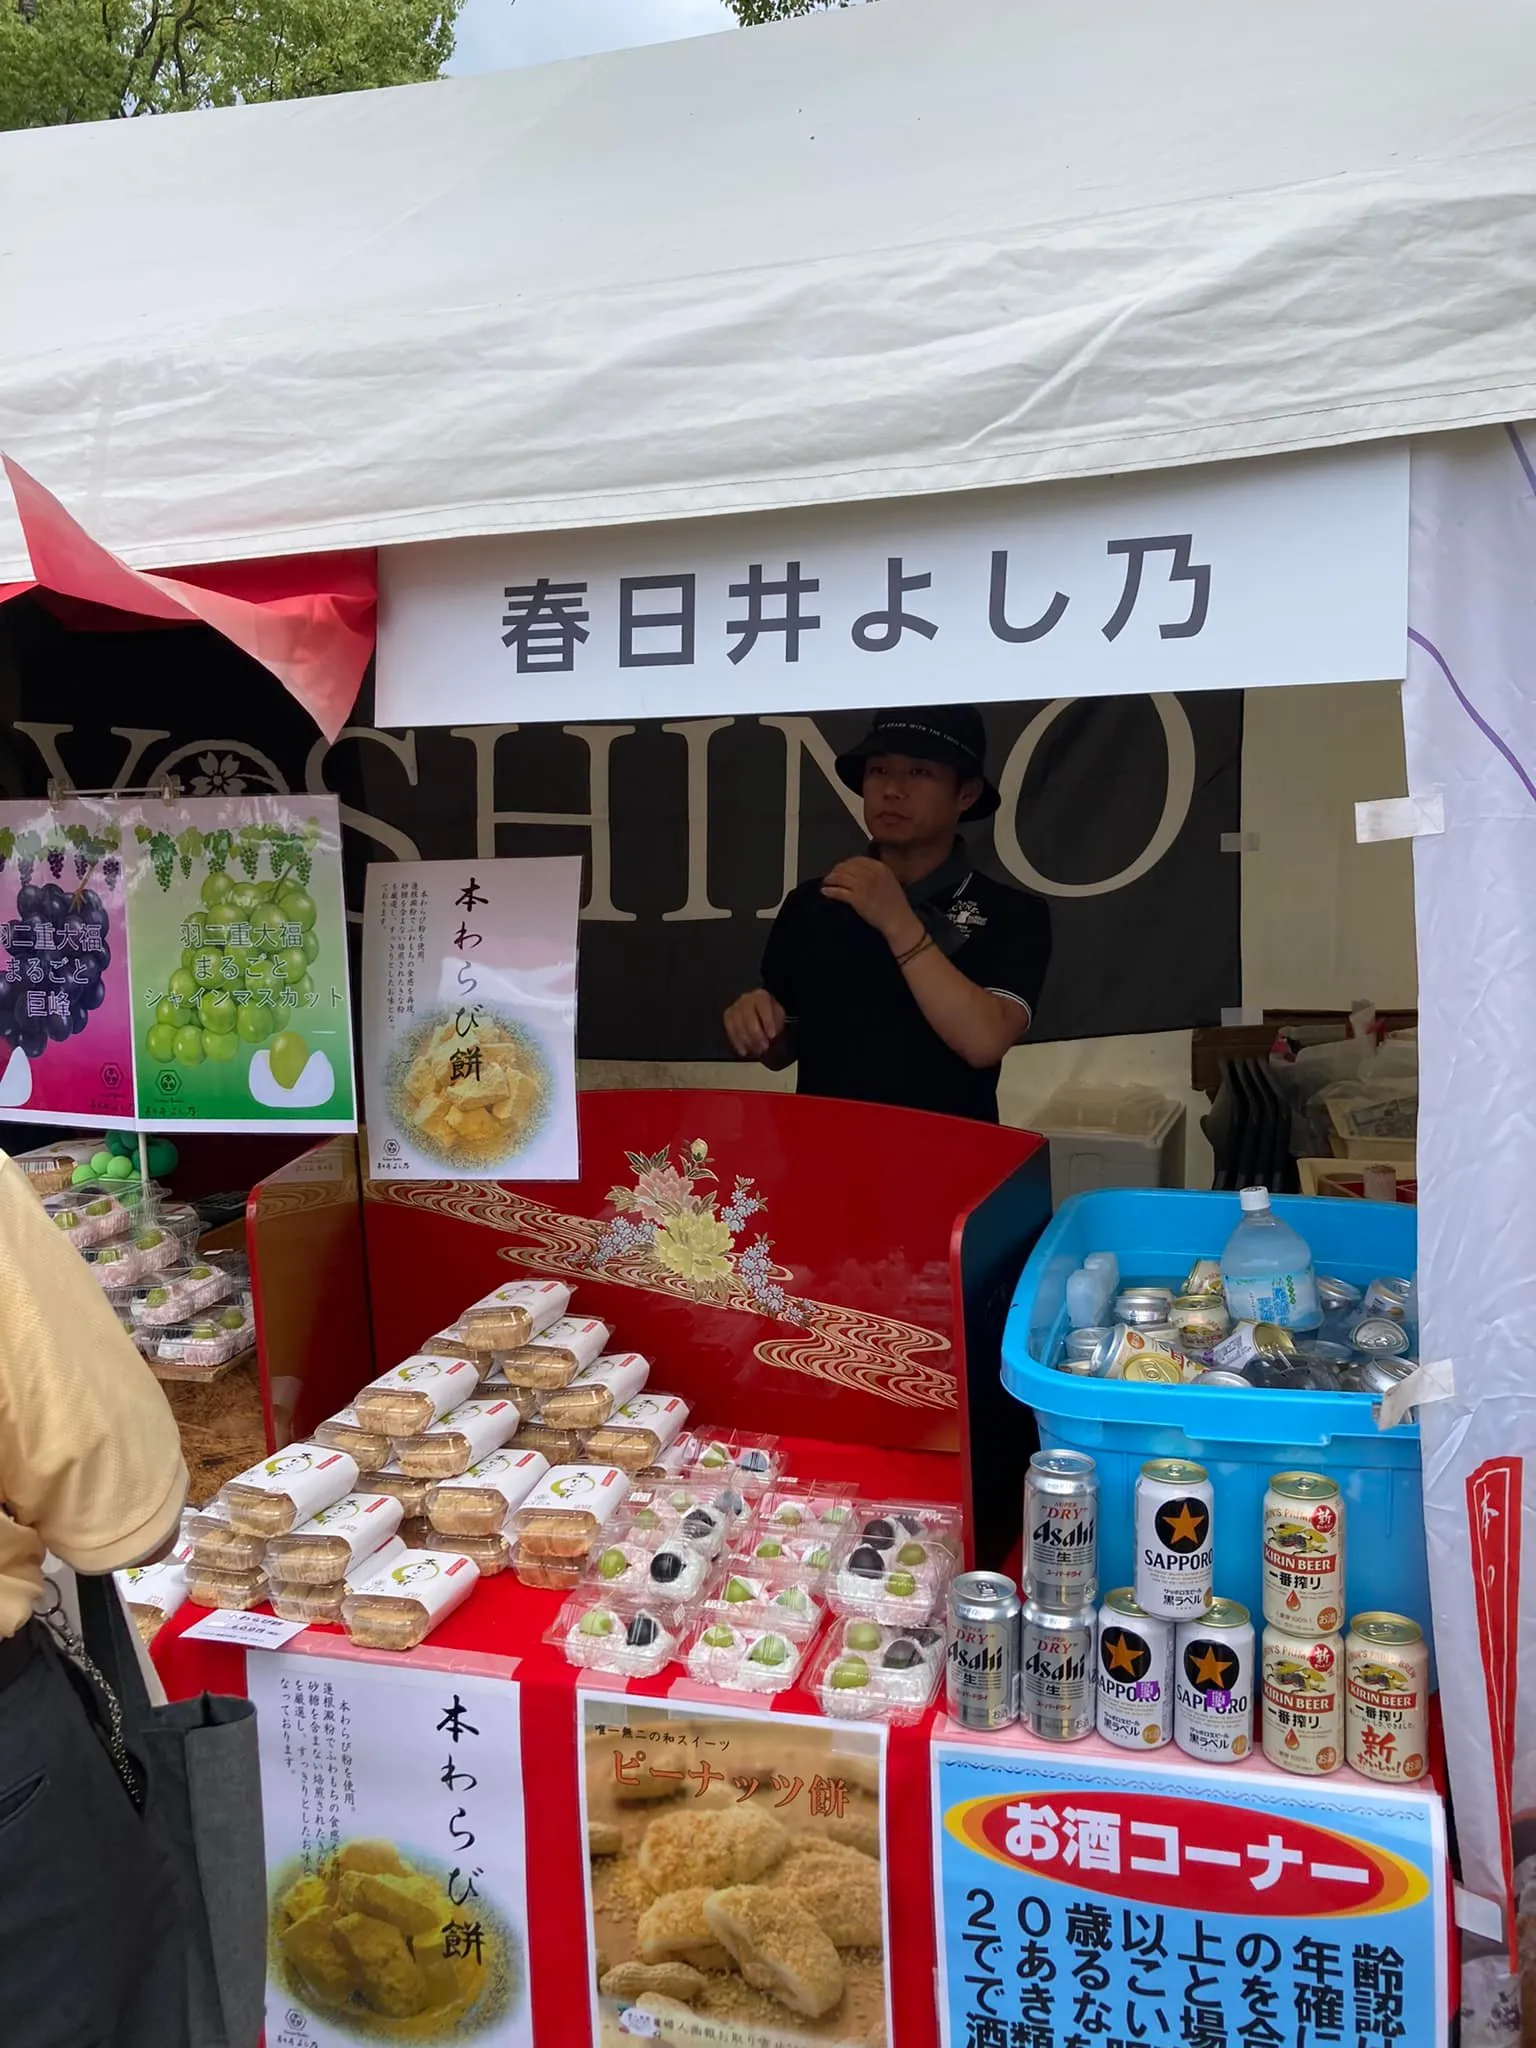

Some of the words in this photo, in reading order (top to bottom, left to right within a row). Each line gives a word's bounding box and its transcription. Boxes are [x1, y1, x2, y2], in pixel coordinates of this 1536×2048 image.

[500, 533, 1213, 674] 春日井よし乃
[179, 922, 304, 948] 羽二重大福
[5, 956, 89, 984] まるごと
[195, 953, 289, 979] まるごと
[450, 877, 489, 1082] 本わらび餅
[27, 990, 71, 1018] 巨峰
[143, 986, 344, 1009] シャインマスカット
[1033, 1517, 1095, 1547] Asahi
[1056, 1551, 1072, 1563] 生
[1264, 1548, 1295, 1570] KIRIN
[1298, 1559, 1331, 1571] BEER
[1269, 1571, 1321, 1590] 一番搾り
[1163, 1595, 1202, 1606] 黒ラベル
[947, 1641, 1003, 1671] Asahi
[1025, 1652, 1085, 1681] Asahi
[963, 1673, 977, 1685] 生
[1045, 1684, 1061, 1697] 生
[1263, 1686, 1294, 1708] KIRIN
[1296, 1698, 1330, 1711] BEER
[1350, 1683, 1380, 1705] KIRIN
[1381, 1695, 1412, 1707] BEER
[1268, 1707, 1320, 1729] 一番搾り
[1355, 1704, 1402, 1722] 一番搾り
[594, 1724, 731, 1752] 唯一無二の和スイーツ
[1361, 1724, 1398, 1764] 新
[613, 1750, 850, 1819] ピーナッツ餅
[436, 1694, 485, 1966] 本わらび餅
[1004, 1803, 1370, 1891] お酒コーナー
[966, 1888, 1406, 1993] 20歳以上の年齢
[962, 1932, 1407, 2036] であることを確認
